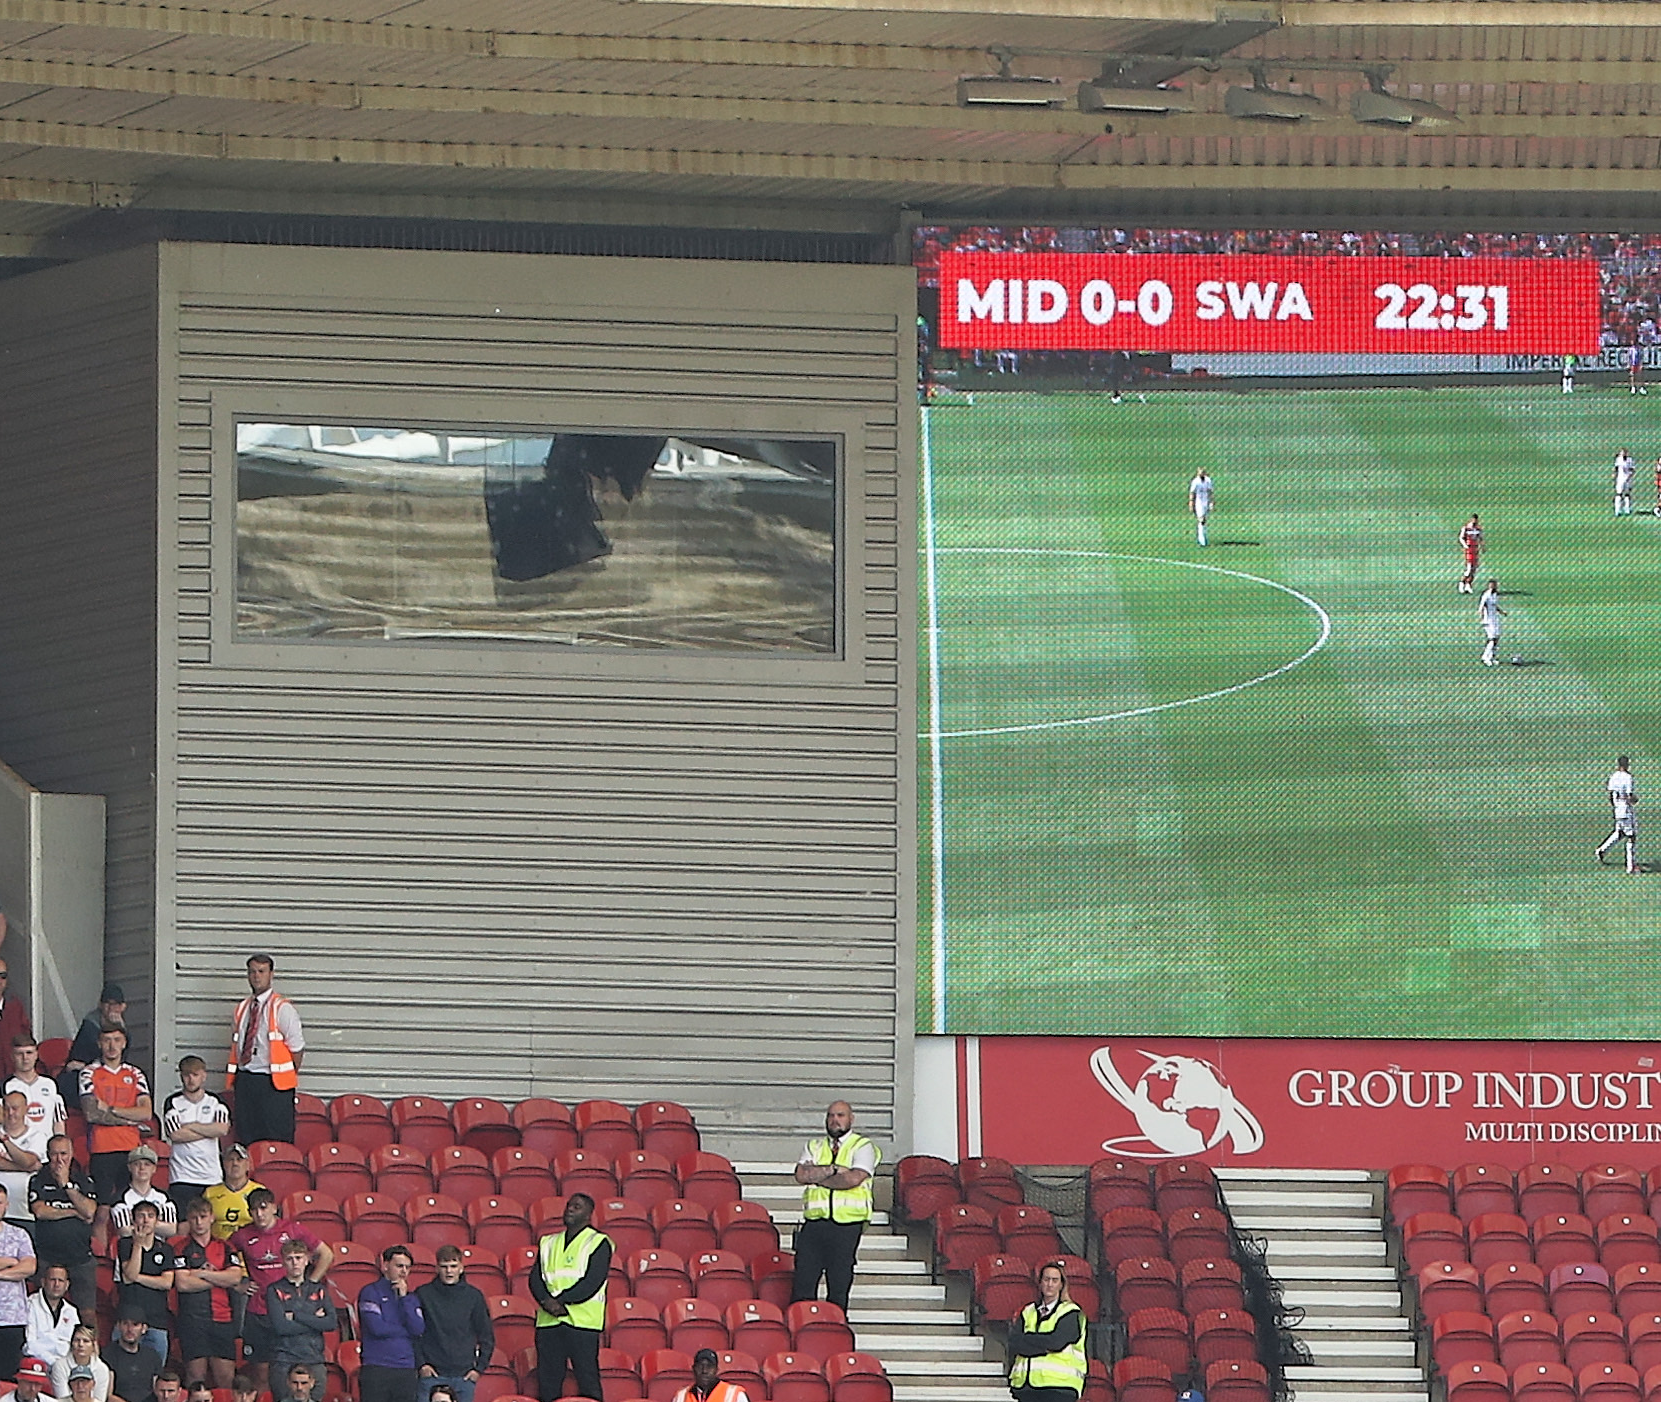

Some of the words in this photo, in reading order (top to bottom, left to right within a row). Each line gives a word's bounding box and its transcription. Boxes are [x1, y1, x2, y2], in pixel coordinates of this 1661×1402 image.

[958, 279, 1068, 324] MID
[1081, 280, 1174, 326] 0-0
[1195, 281, 1314, 321] SWA
[1375, 283, 1510, 331] 22:31
[1288, 1069, 1464, 1109] GROUP
[1464, 1122, 1545, 1143] MULTI
